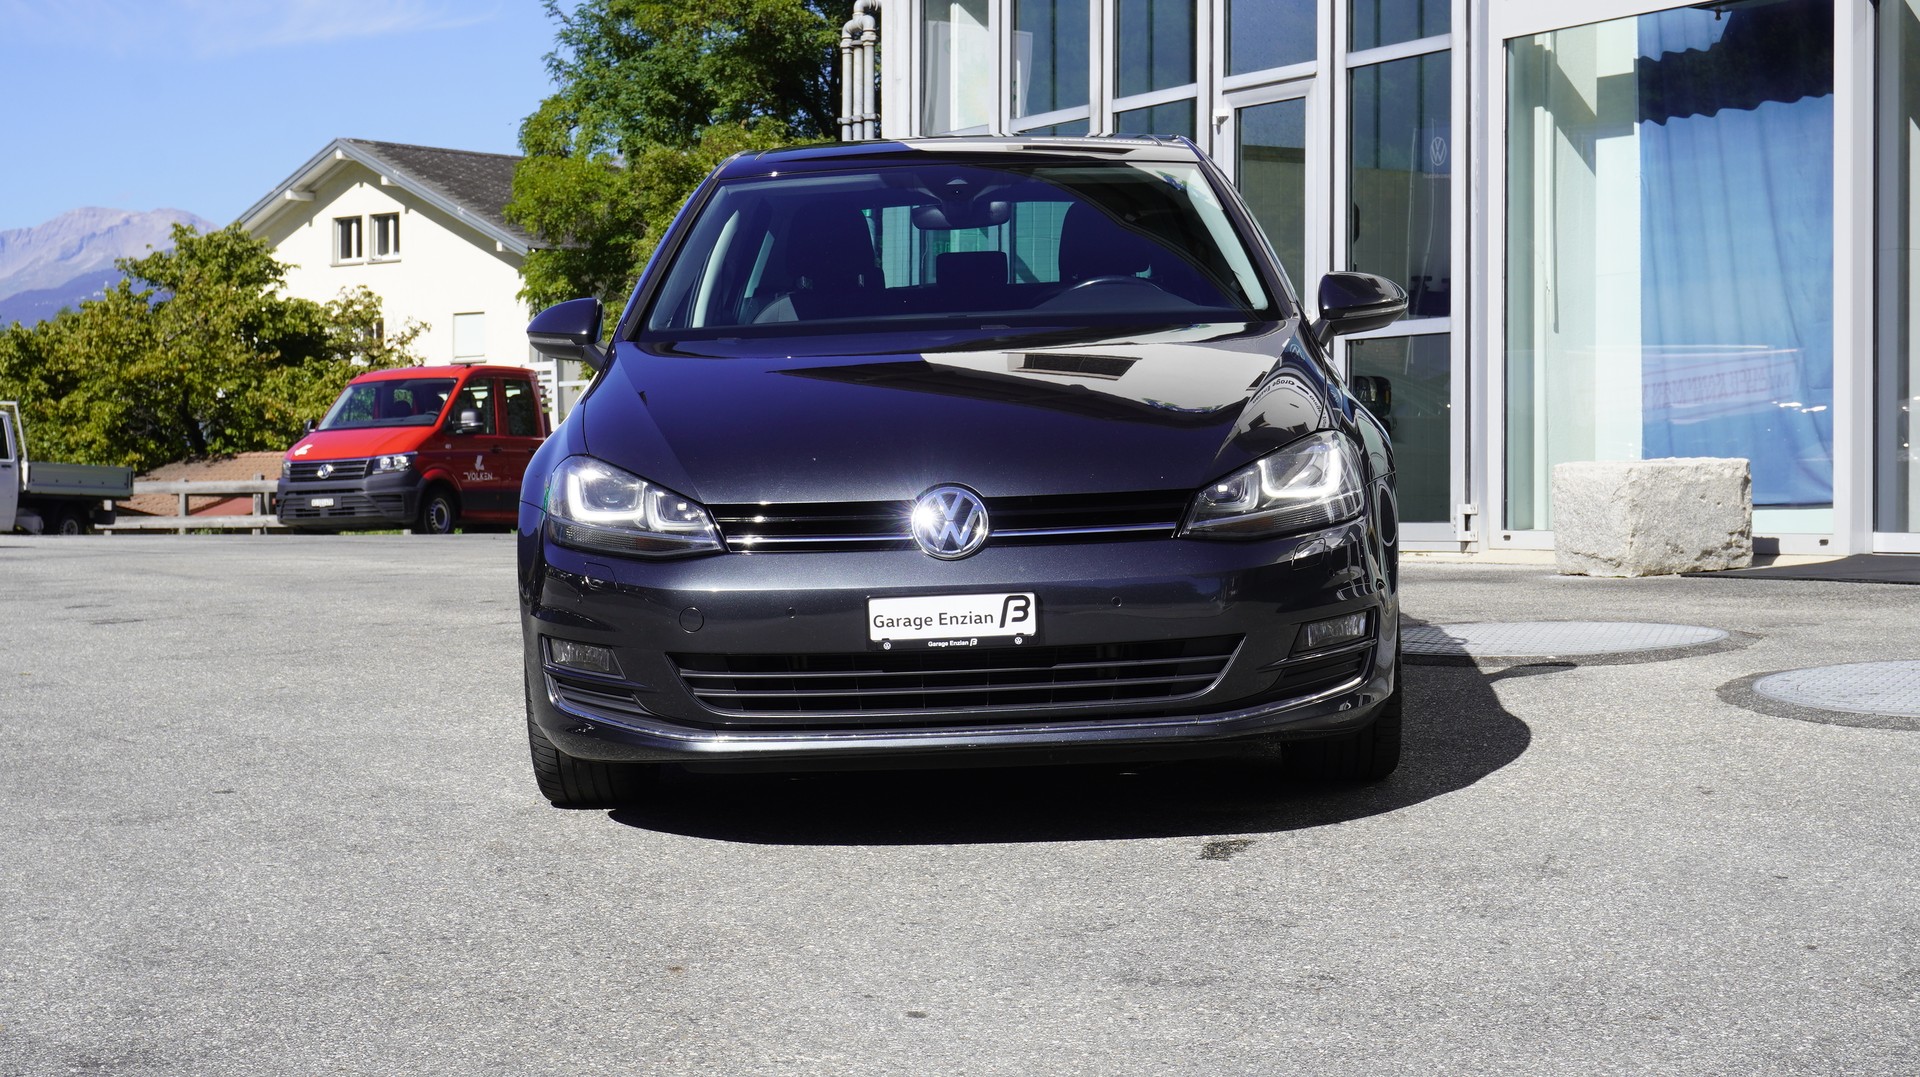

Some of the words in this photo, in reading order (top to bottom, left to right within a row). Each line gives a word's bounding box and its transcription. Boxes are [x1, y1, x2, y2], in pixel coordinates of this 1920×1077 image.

[873, 614, 933, 630] Garage
[938, 611, 994, 626] Enzian
[928, 640, 949, 648] Garage
[949, 639, 969, 647] Enzian
